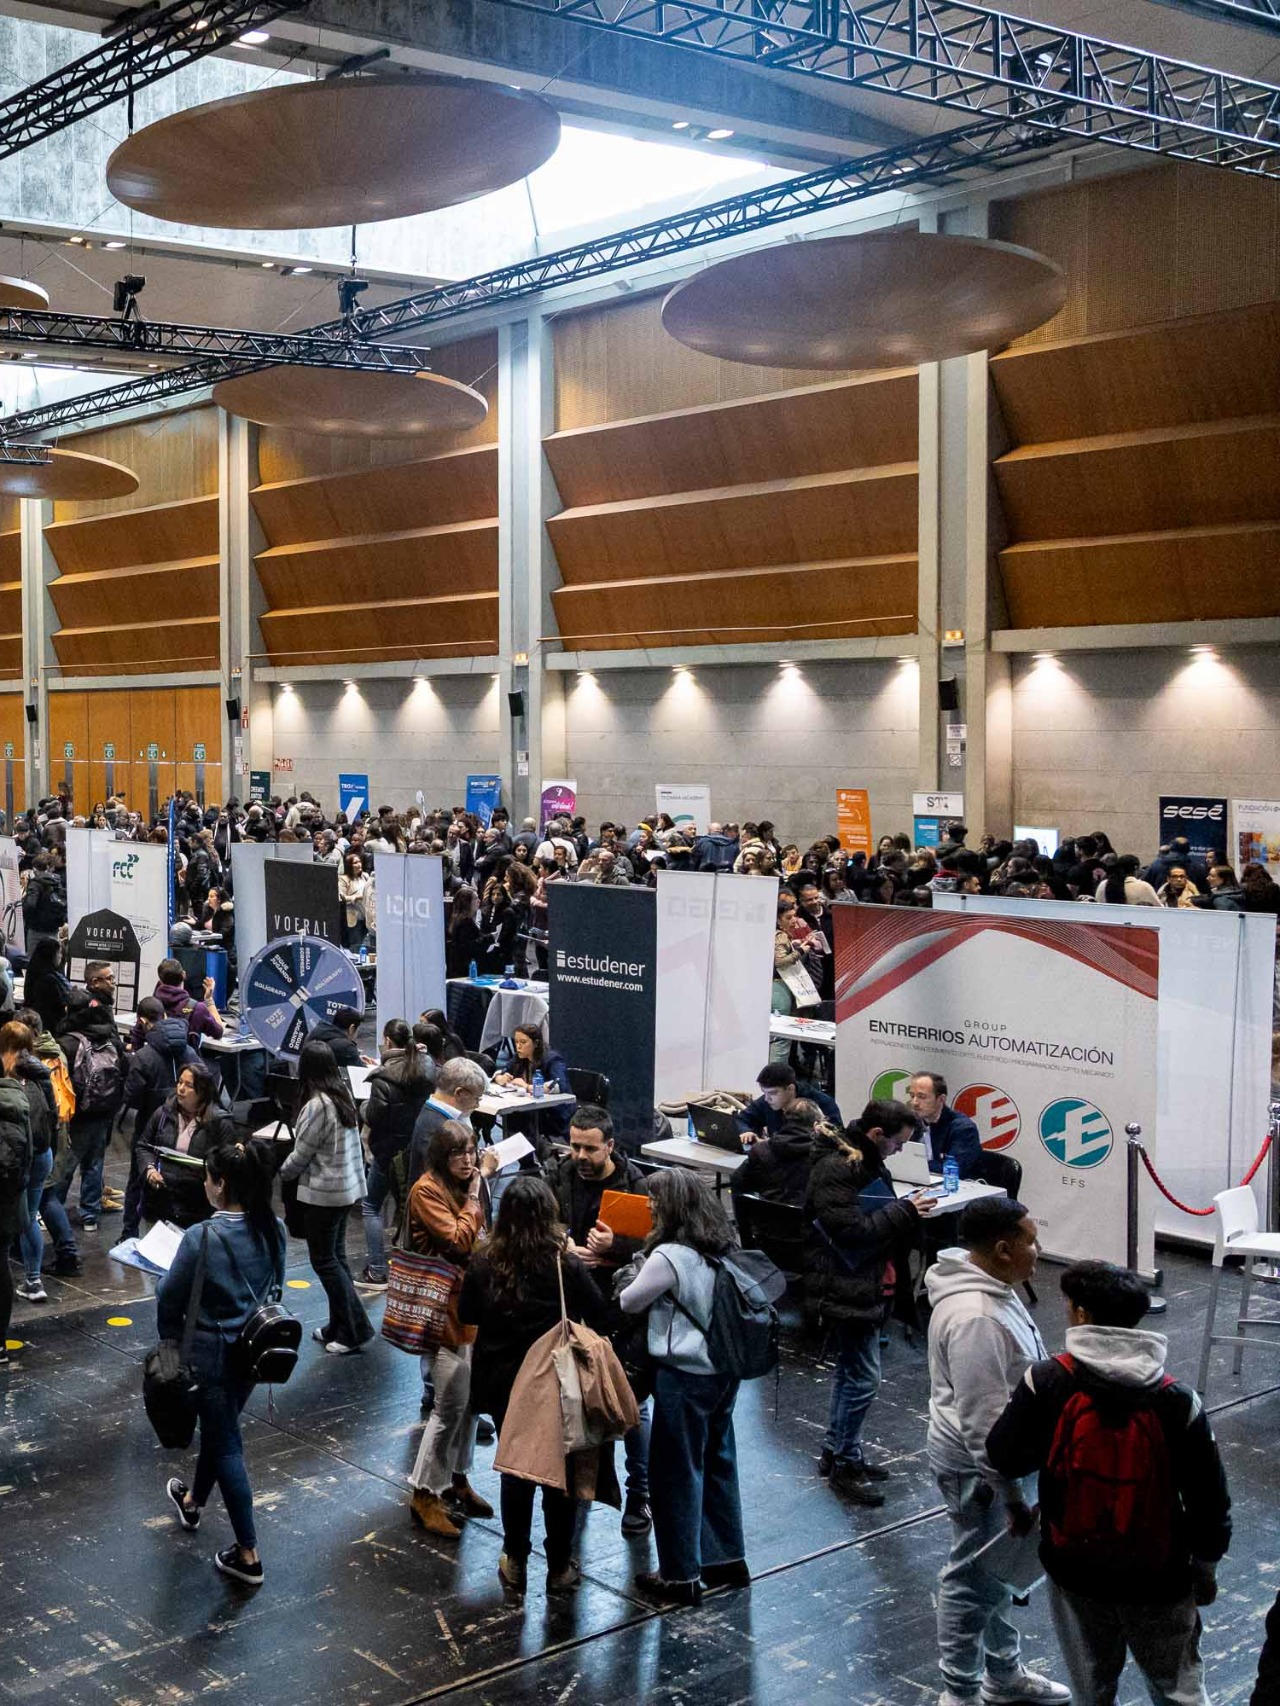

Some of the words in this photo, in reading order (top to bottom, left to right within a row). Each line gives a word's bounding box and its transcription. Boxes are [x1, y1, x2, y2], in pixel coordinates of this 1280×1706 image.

[113, 862, 133, 879] FCC
[86, 927, 124, 939] VOERAL
[274, 914, 328, 937] VOERAL
[270, 957, 292, 984] JUGANDO
[567, 954, 645, 976] estudener
[556, 974, 643, 992] www.estudener.com
[265, 1008, 282, 1024] TOTE
[288, 1018, 302, 1048] JUGANDO
[964, 1020, 1007, 1031] GROUP
[870, 1020, 965, 1044] ENTRERRIOS
[968, 1034, 1114, 1066] AUTOMATIZACIÓN
[1062, 1176, 1086, 1188] EFS
